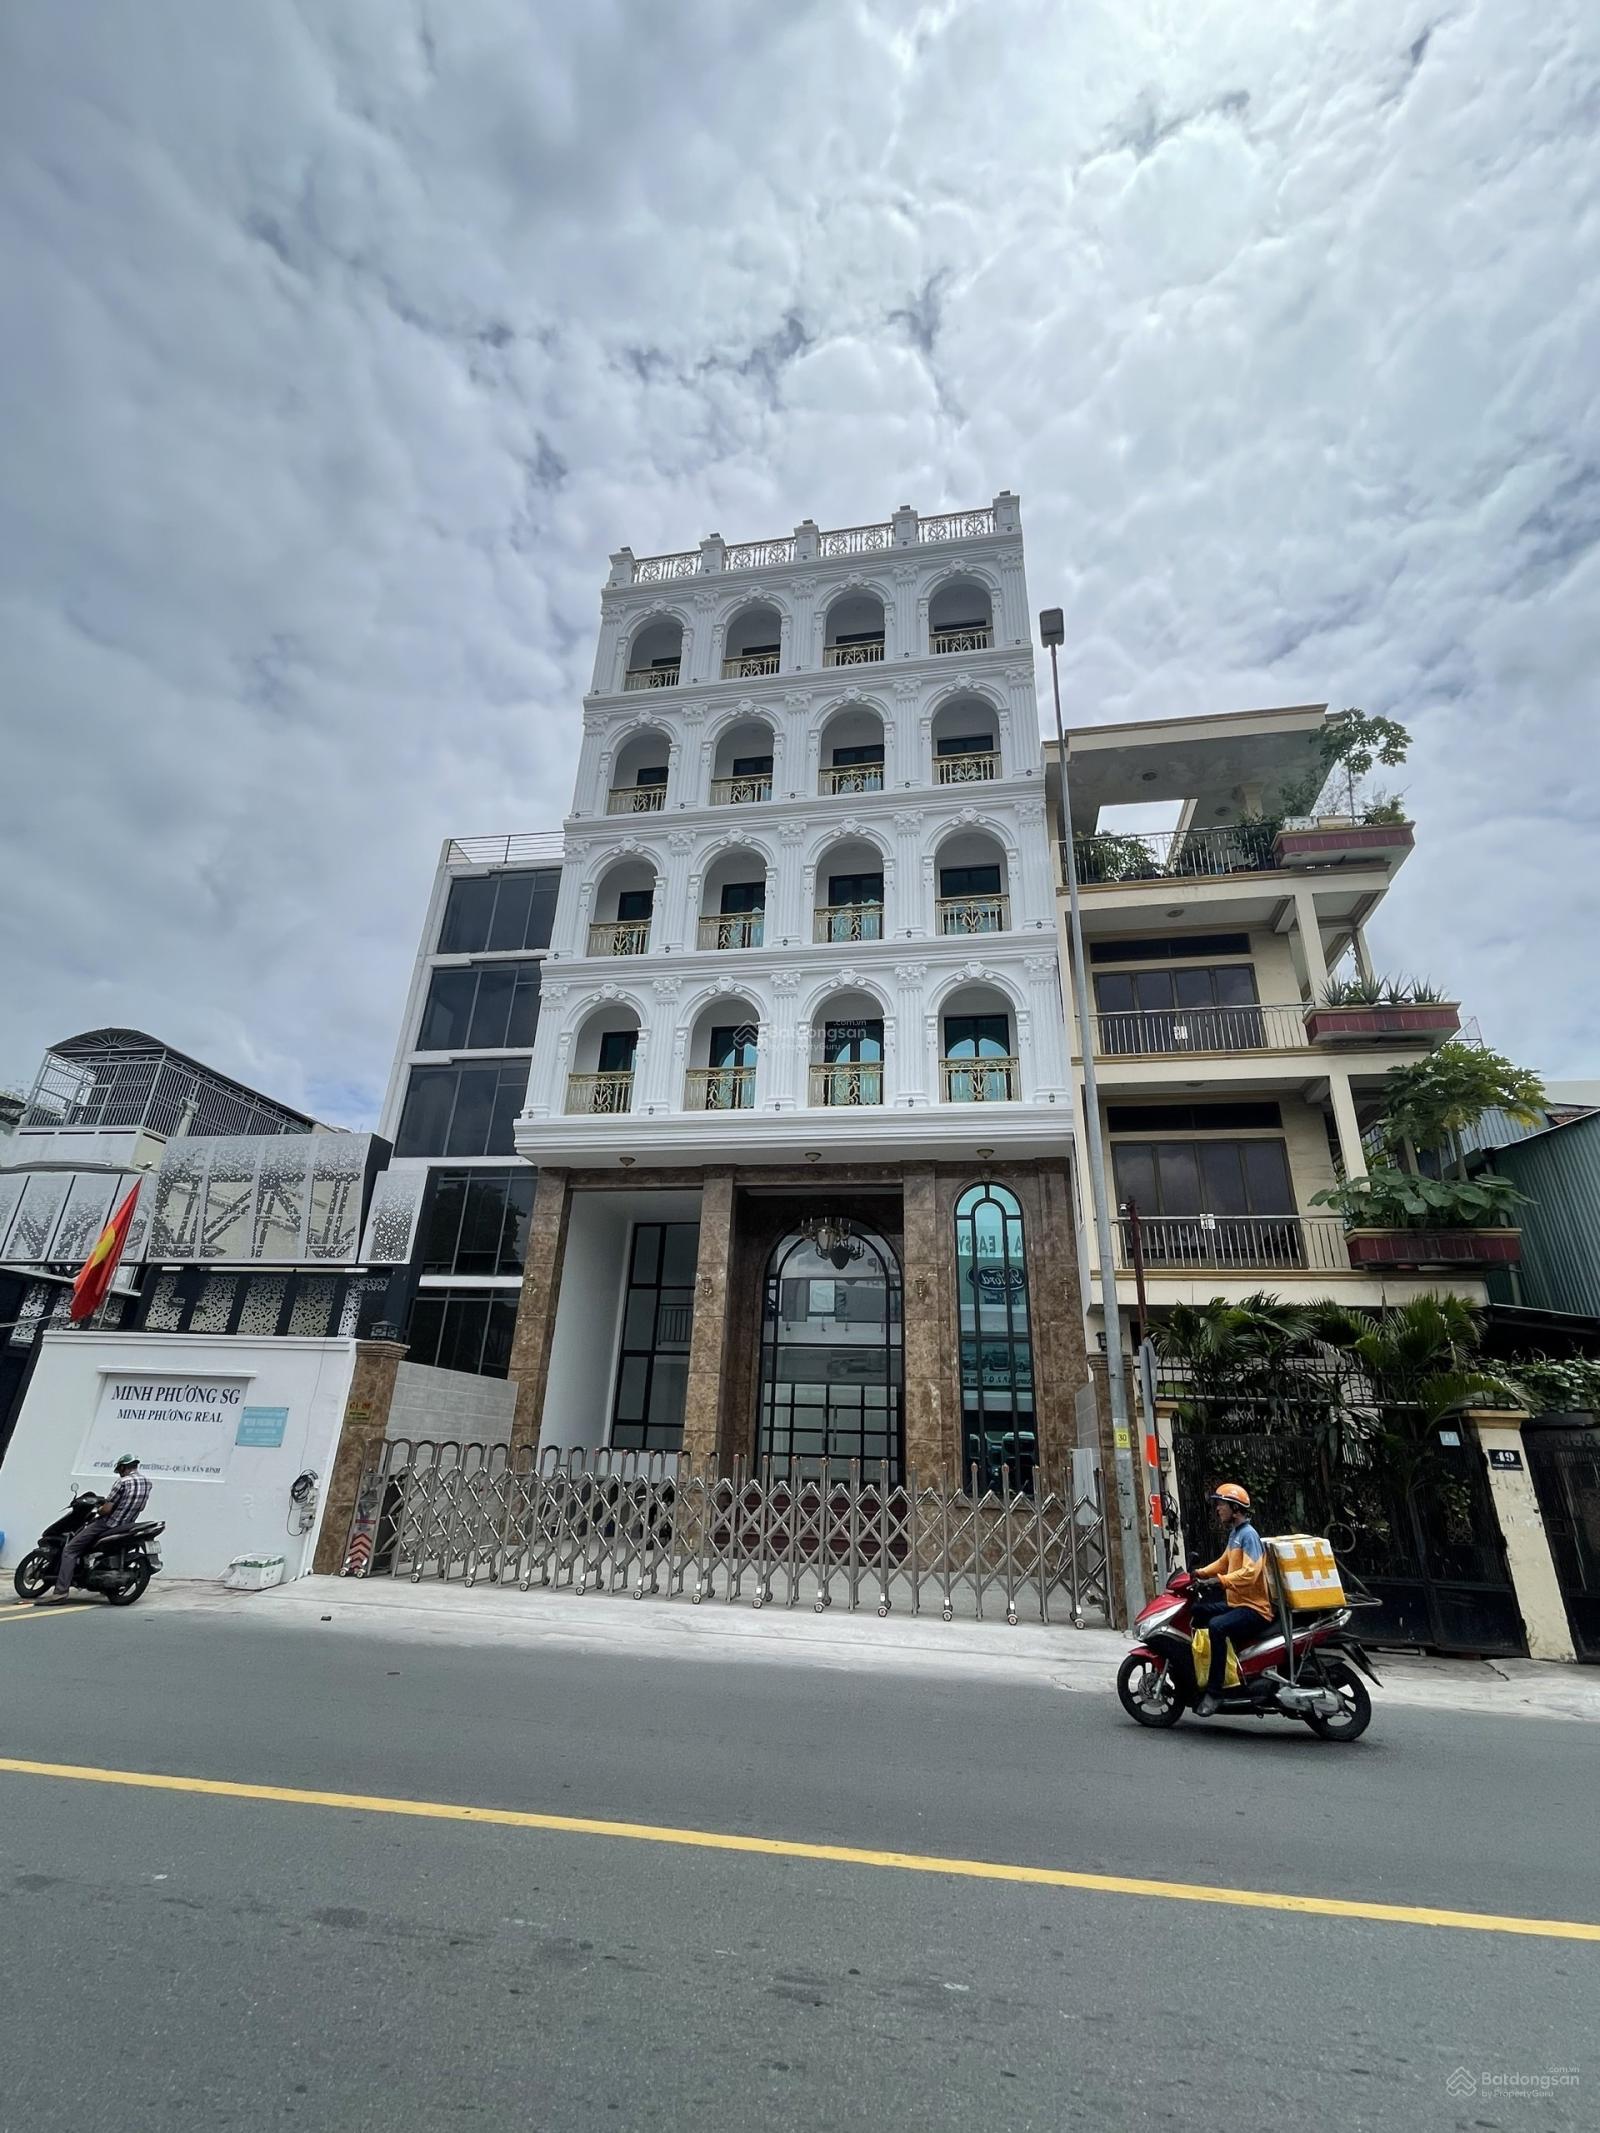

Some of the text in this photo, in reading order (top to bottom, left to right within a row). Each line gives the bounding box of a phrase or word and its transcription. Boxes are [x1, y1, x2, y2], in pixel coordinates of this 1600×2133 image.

[112, 1384, 240, 1404] MINH PHƯƠNG SG
[117, 1409, 223, 1423] MINH PHƯƠNG REAL
[1118, 1433, 1127, 1442] 30
[1495, 1451, 1515, 1462] 49
